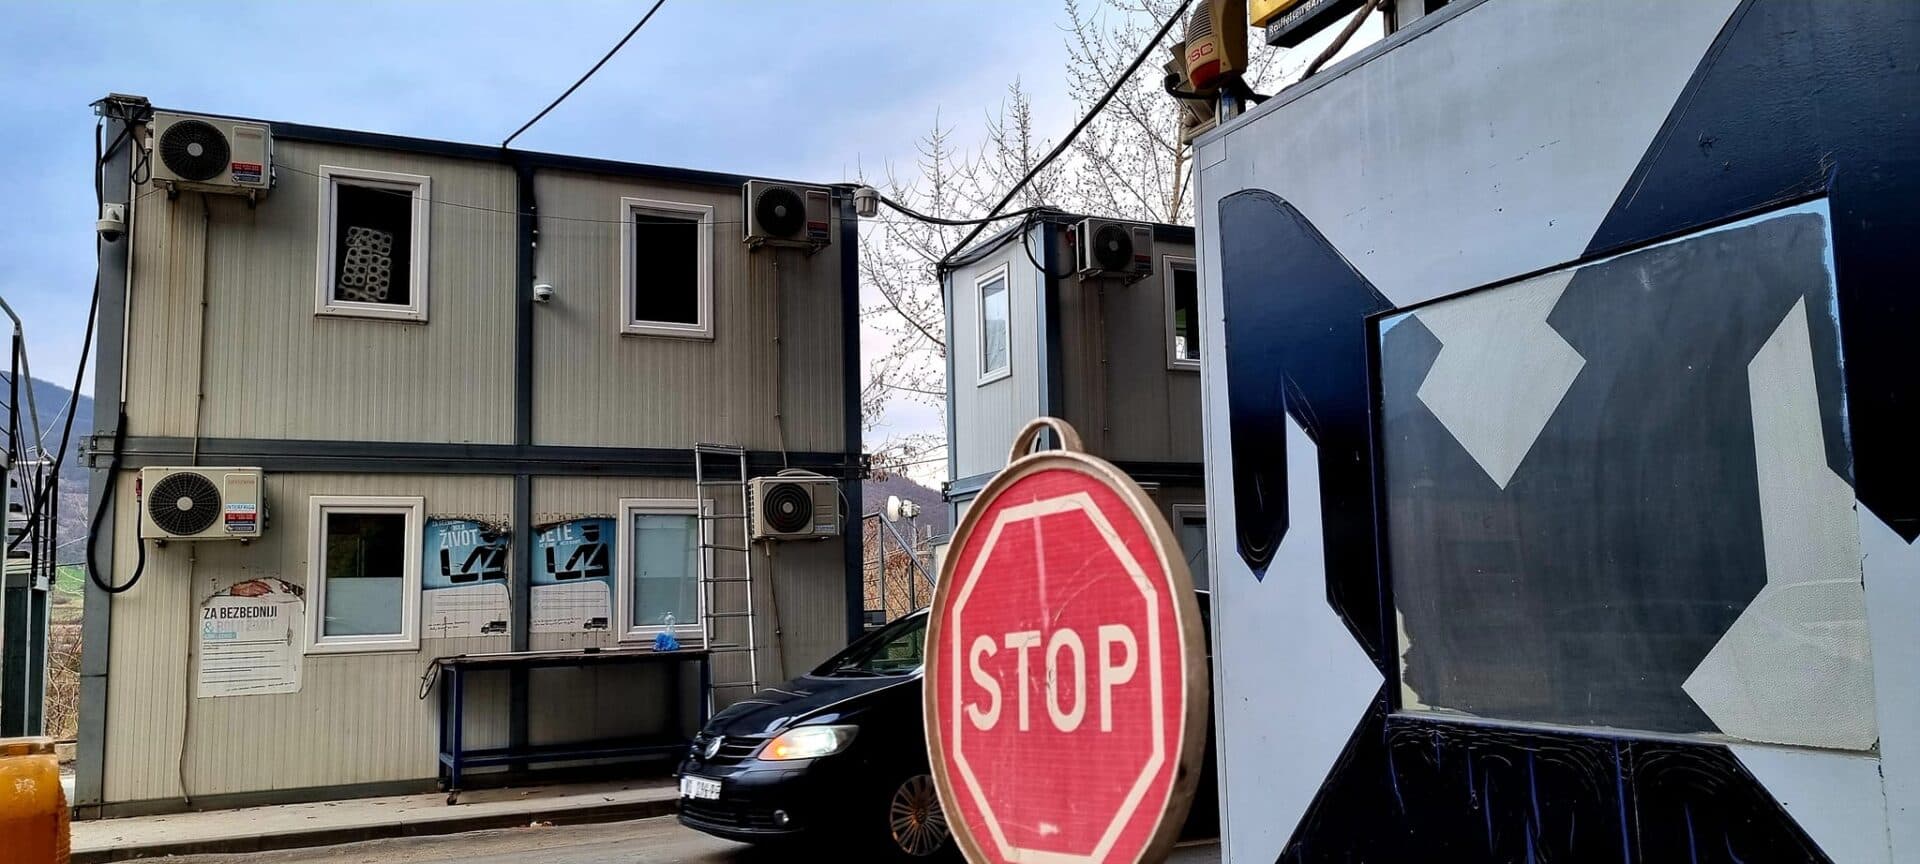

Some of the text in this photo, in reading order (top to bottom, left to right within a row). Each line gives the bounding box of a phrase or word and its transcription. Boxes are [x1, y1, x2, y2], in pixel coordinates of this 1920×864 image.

[440, 529, 478, 549] ŽIVOT
[204, 606, 278, 620] ZA BEZBEDNIJI
[965, 624, 1138, 732] STOP
